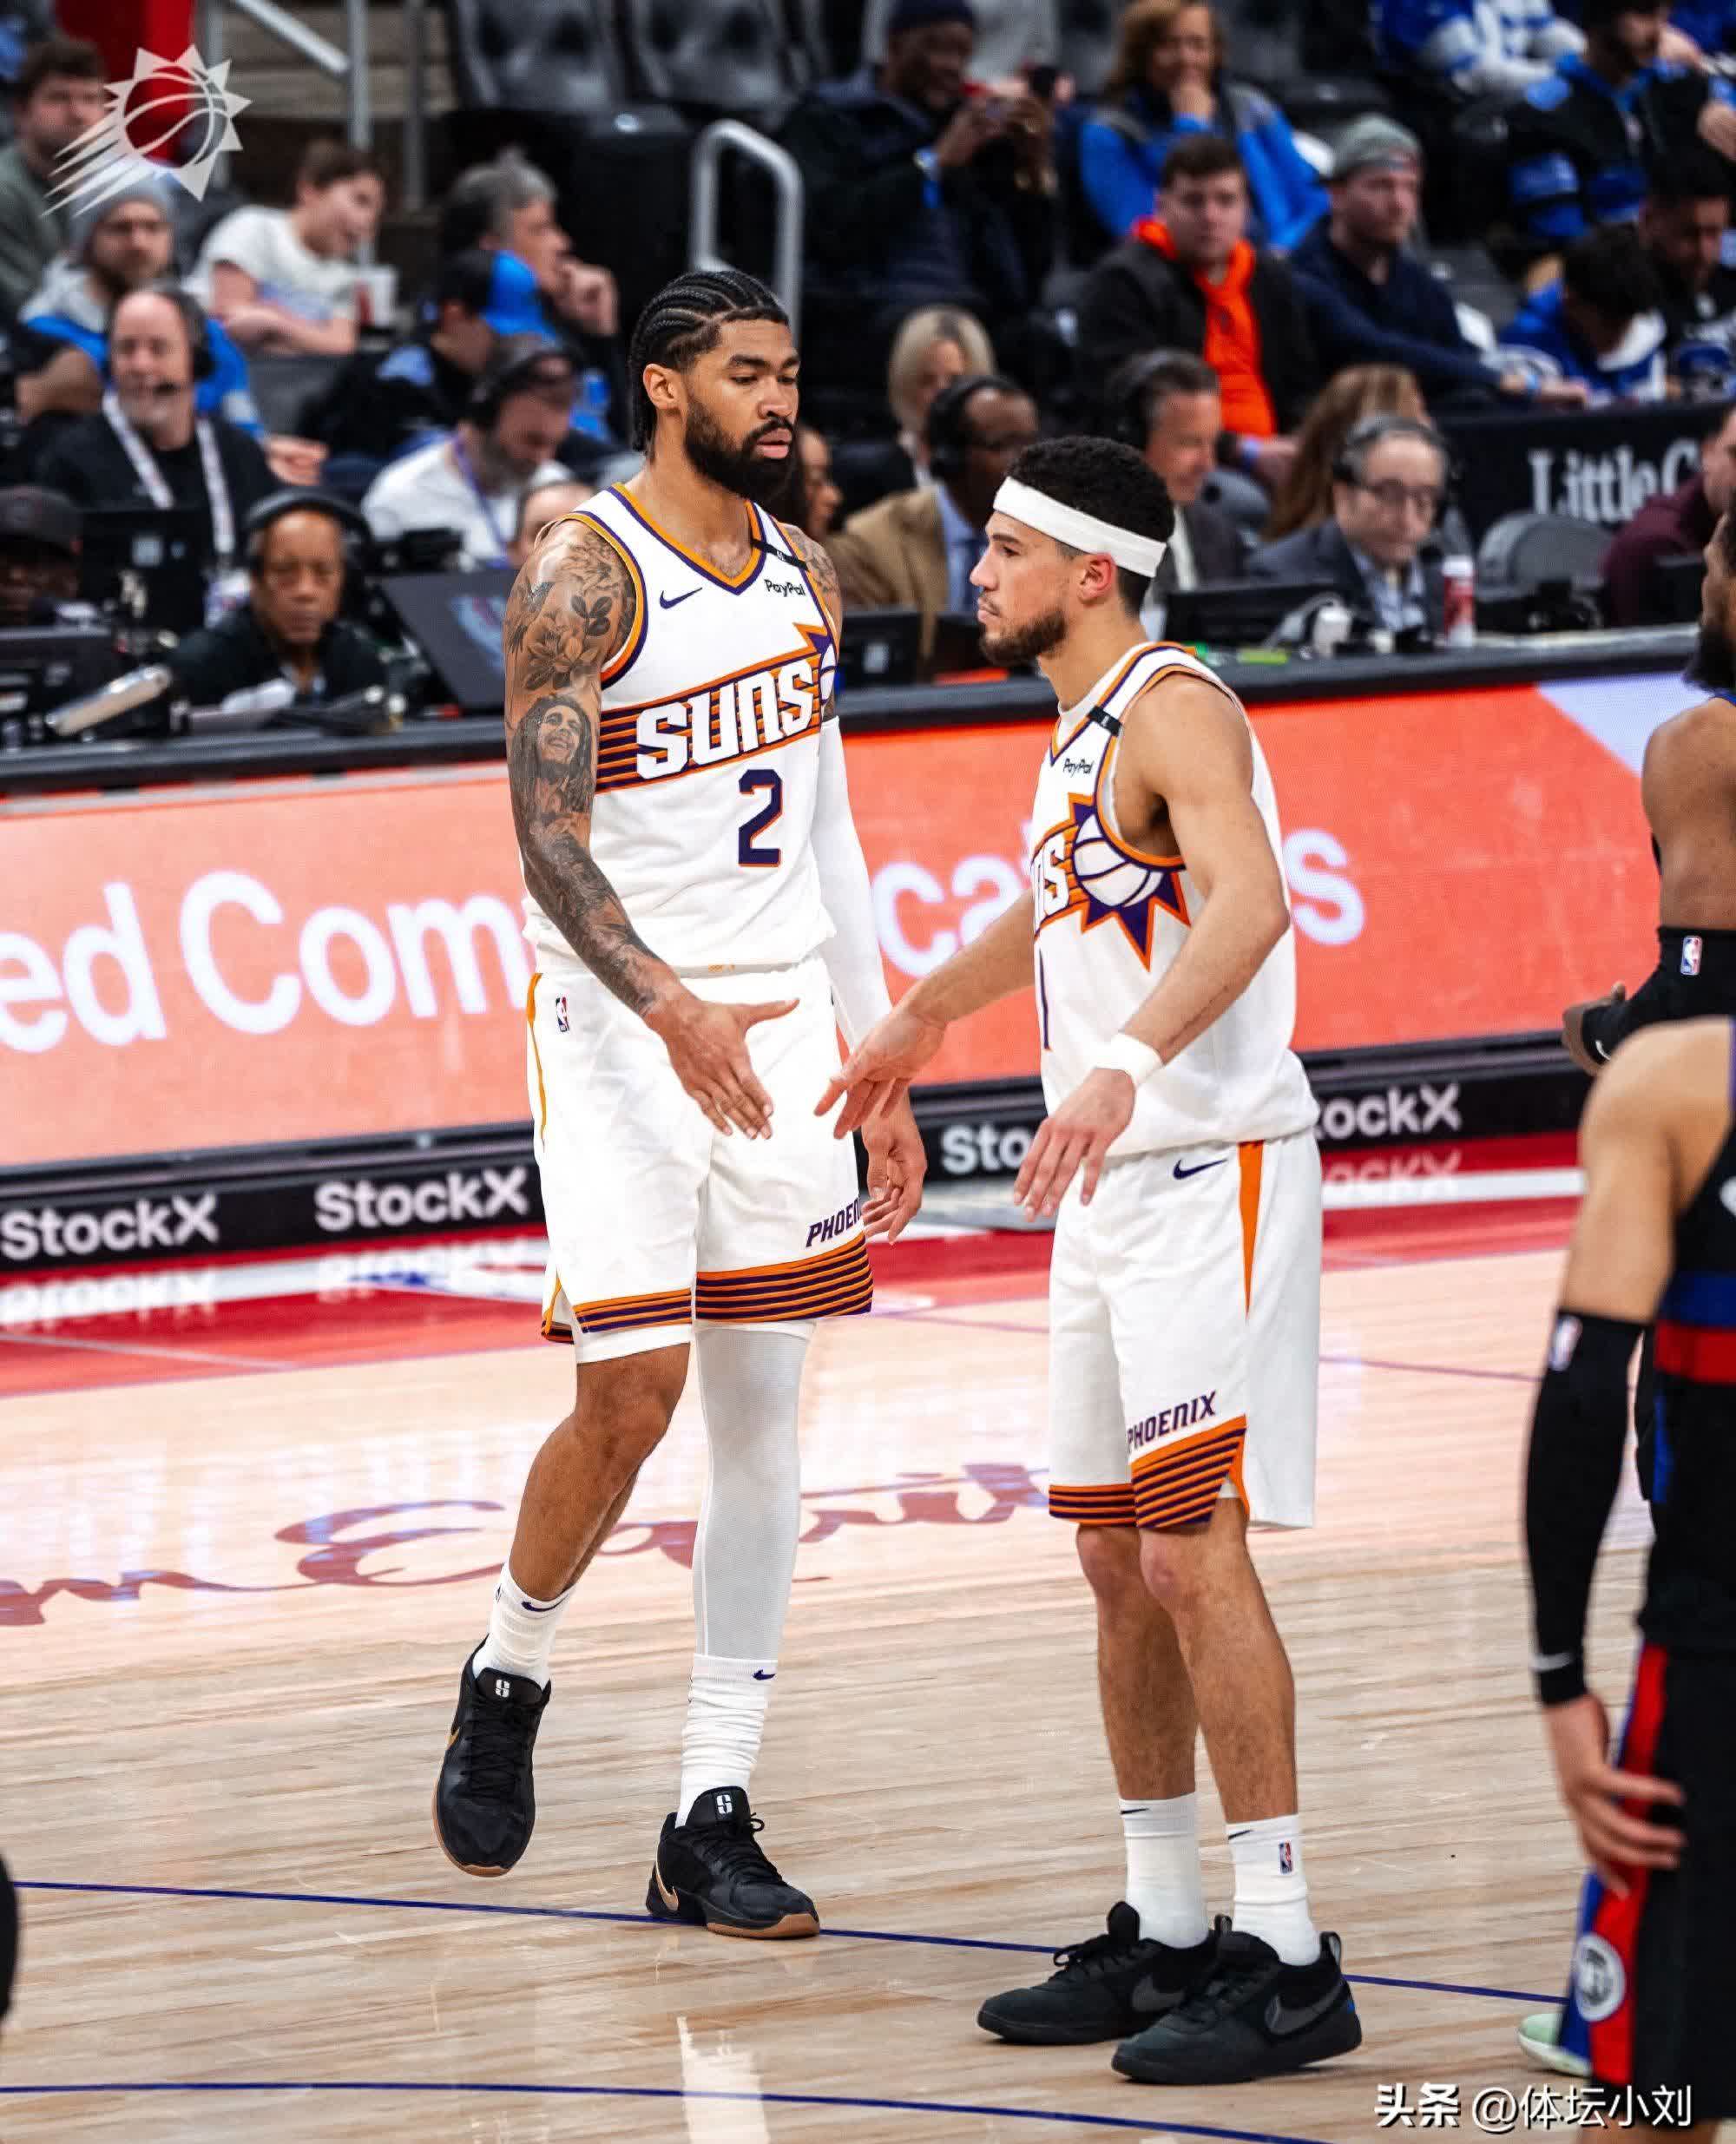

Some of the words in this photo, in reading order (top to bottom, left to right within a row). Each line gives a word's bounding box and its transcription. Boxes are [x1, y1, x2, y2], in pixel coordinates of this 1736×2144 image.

[764, 578, 806, 598] PayPal
[636, 659, 815, 779] SUNS
[1062, 758, 1095, 778] PayPal
[738, 768, 783, 867] 2
[1316, 1082, 1463, 1141] ockX
[941, 1121, 1033, 1174] Sto
[1, 1194, 219, 1260] StockX
[314, 1167, 529, 1232] StockX
[806, 1197, 862, 1248] PHOEN
[1126, 1389, 1217, 1454] PHOENIX
